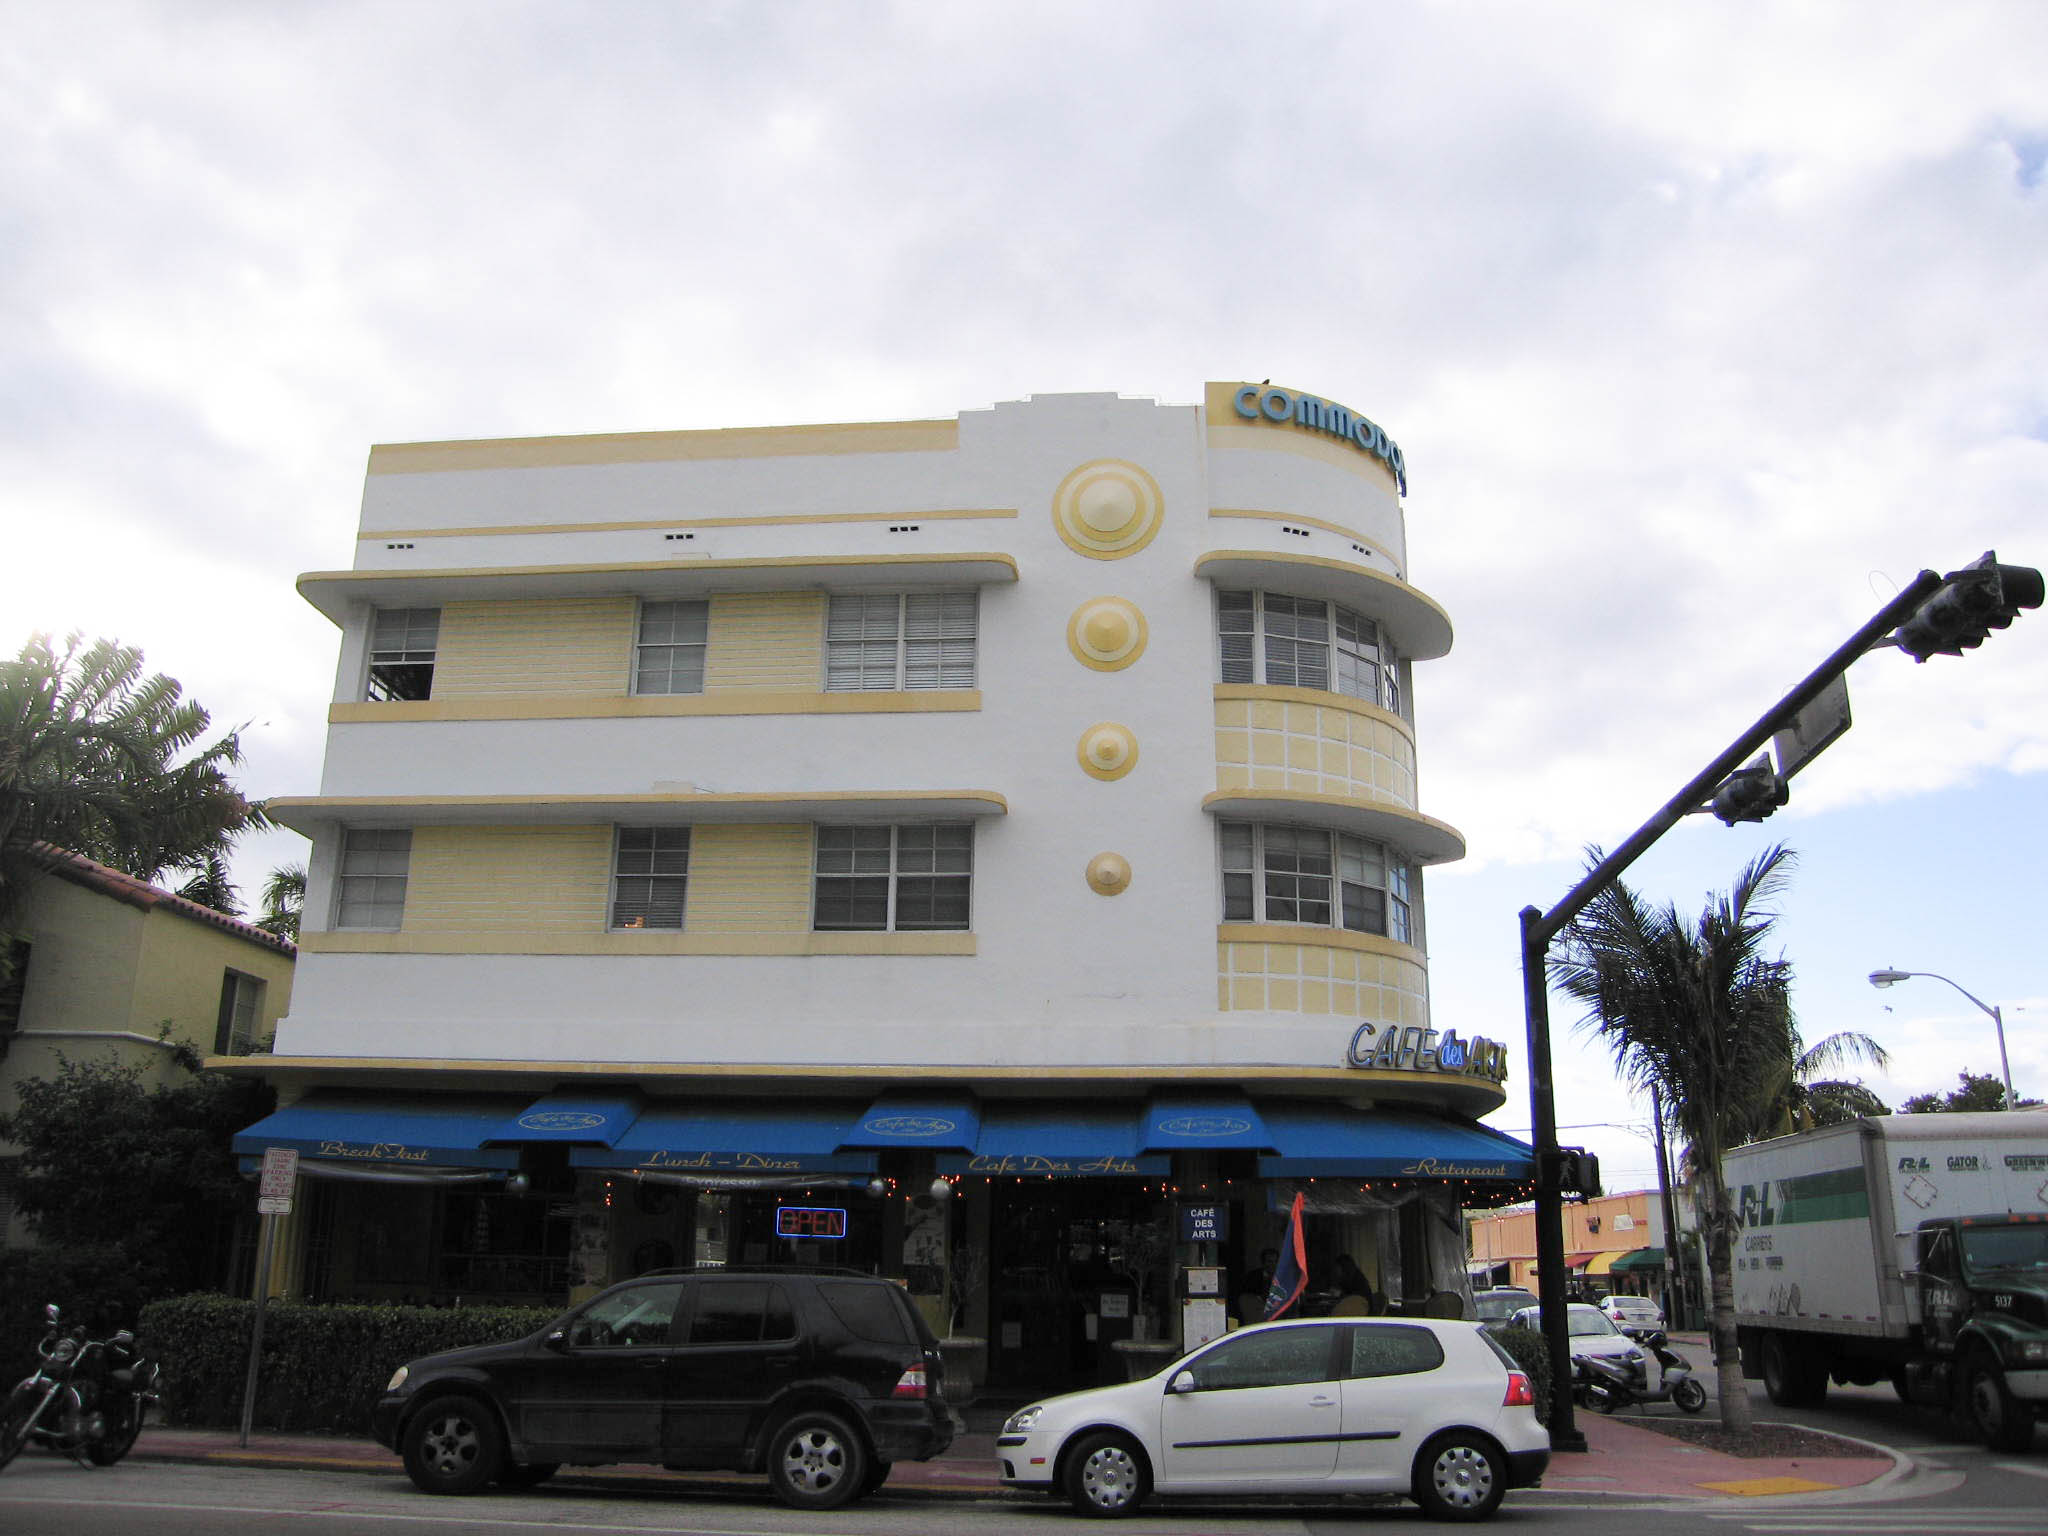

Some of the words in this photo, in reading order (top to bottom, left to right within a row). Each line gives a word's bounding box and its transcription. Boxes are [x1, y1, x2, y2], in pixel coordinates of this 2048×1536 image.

[1347, 1022, 1439, 1069] CAFE
[1435, 1029, 1468, 1071] des
[638, 1150, 713, 1168] Lunch
[736, 1152, 800, 1169] Diner
[968, 1154, 1017, 1174] Cafe
[1024, 1155, 1072, 1172] Des
[1078, 1154, 1138, 1173] Arts
[1946, 1156, 1979, 1169] GATOR
[1190, 1208, 1215, 1217] CAFÉ
[779, 1208, 844, 1235] OPEN
[1194, 1219, 1214, 1228] DES
[1191, 1230, 1217, 1239] ARTS
